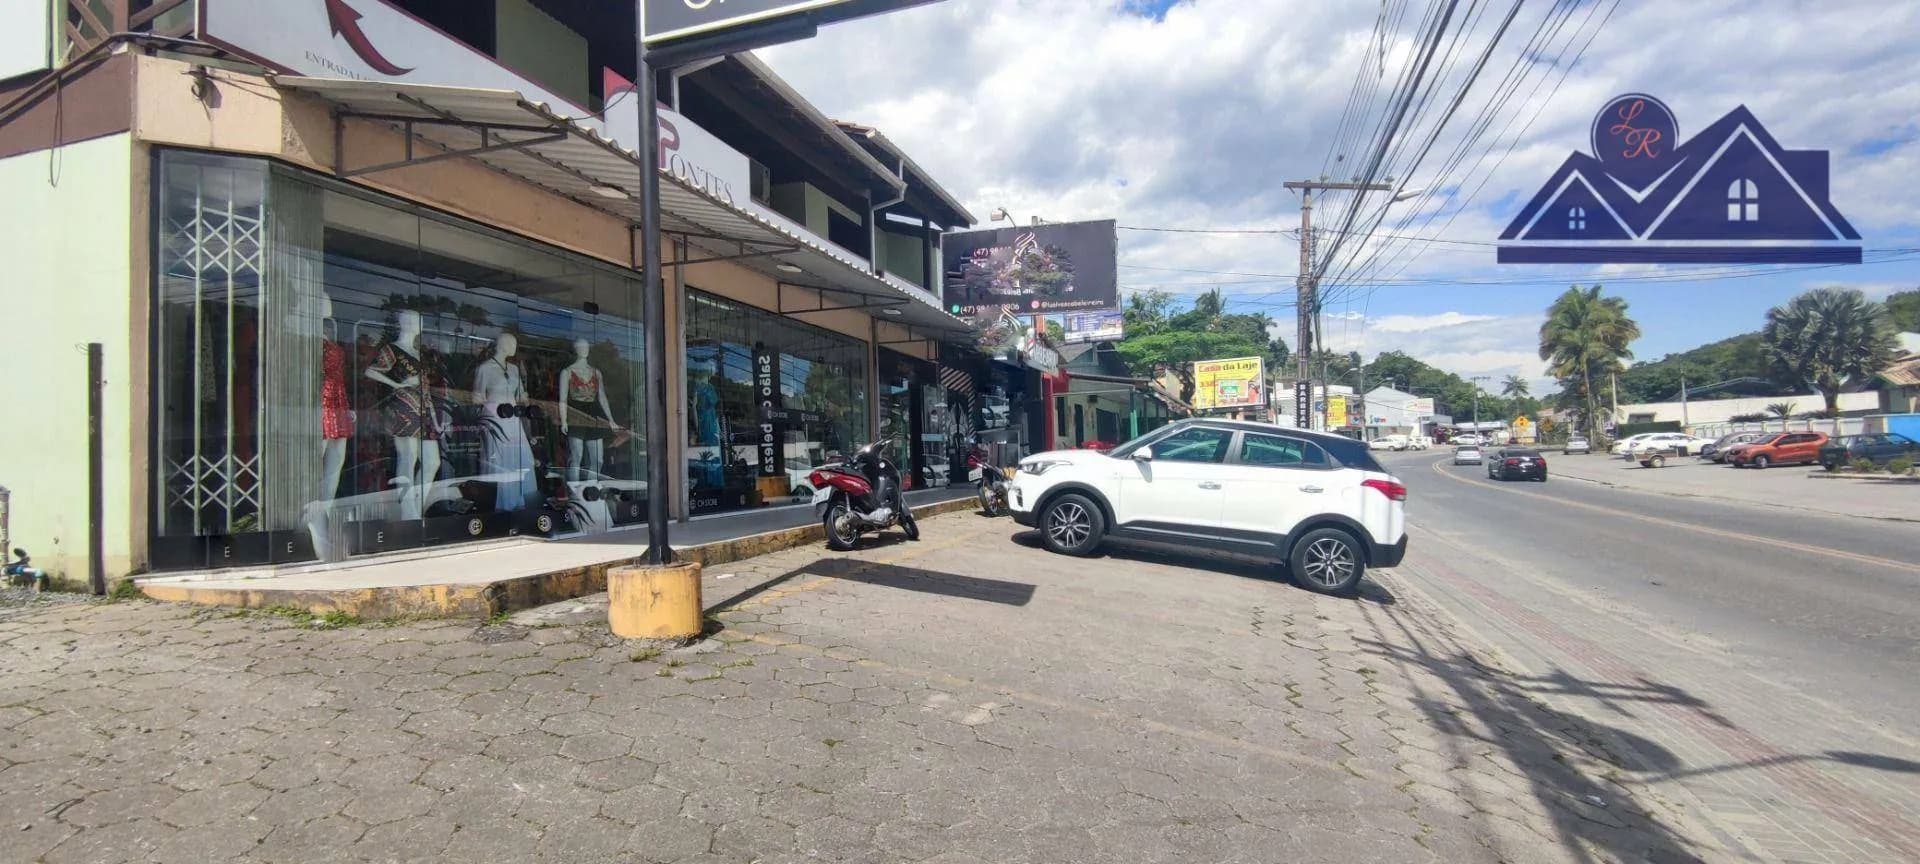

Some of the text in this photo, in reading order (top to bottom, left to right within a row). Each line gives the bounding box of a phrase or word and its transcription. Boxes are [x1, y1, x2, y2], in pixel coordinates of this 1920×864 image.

[304, 50, 354, 80] ENTRADA
[973, 247, 989, 257] (47)
[960, 305, 975, 315] (47)
[1223, 362, 1235, 371] da
[1237, 360, 1258, 370] Laje
[224, 546, 231, 558] E
[287, 541, 293, 553] E
